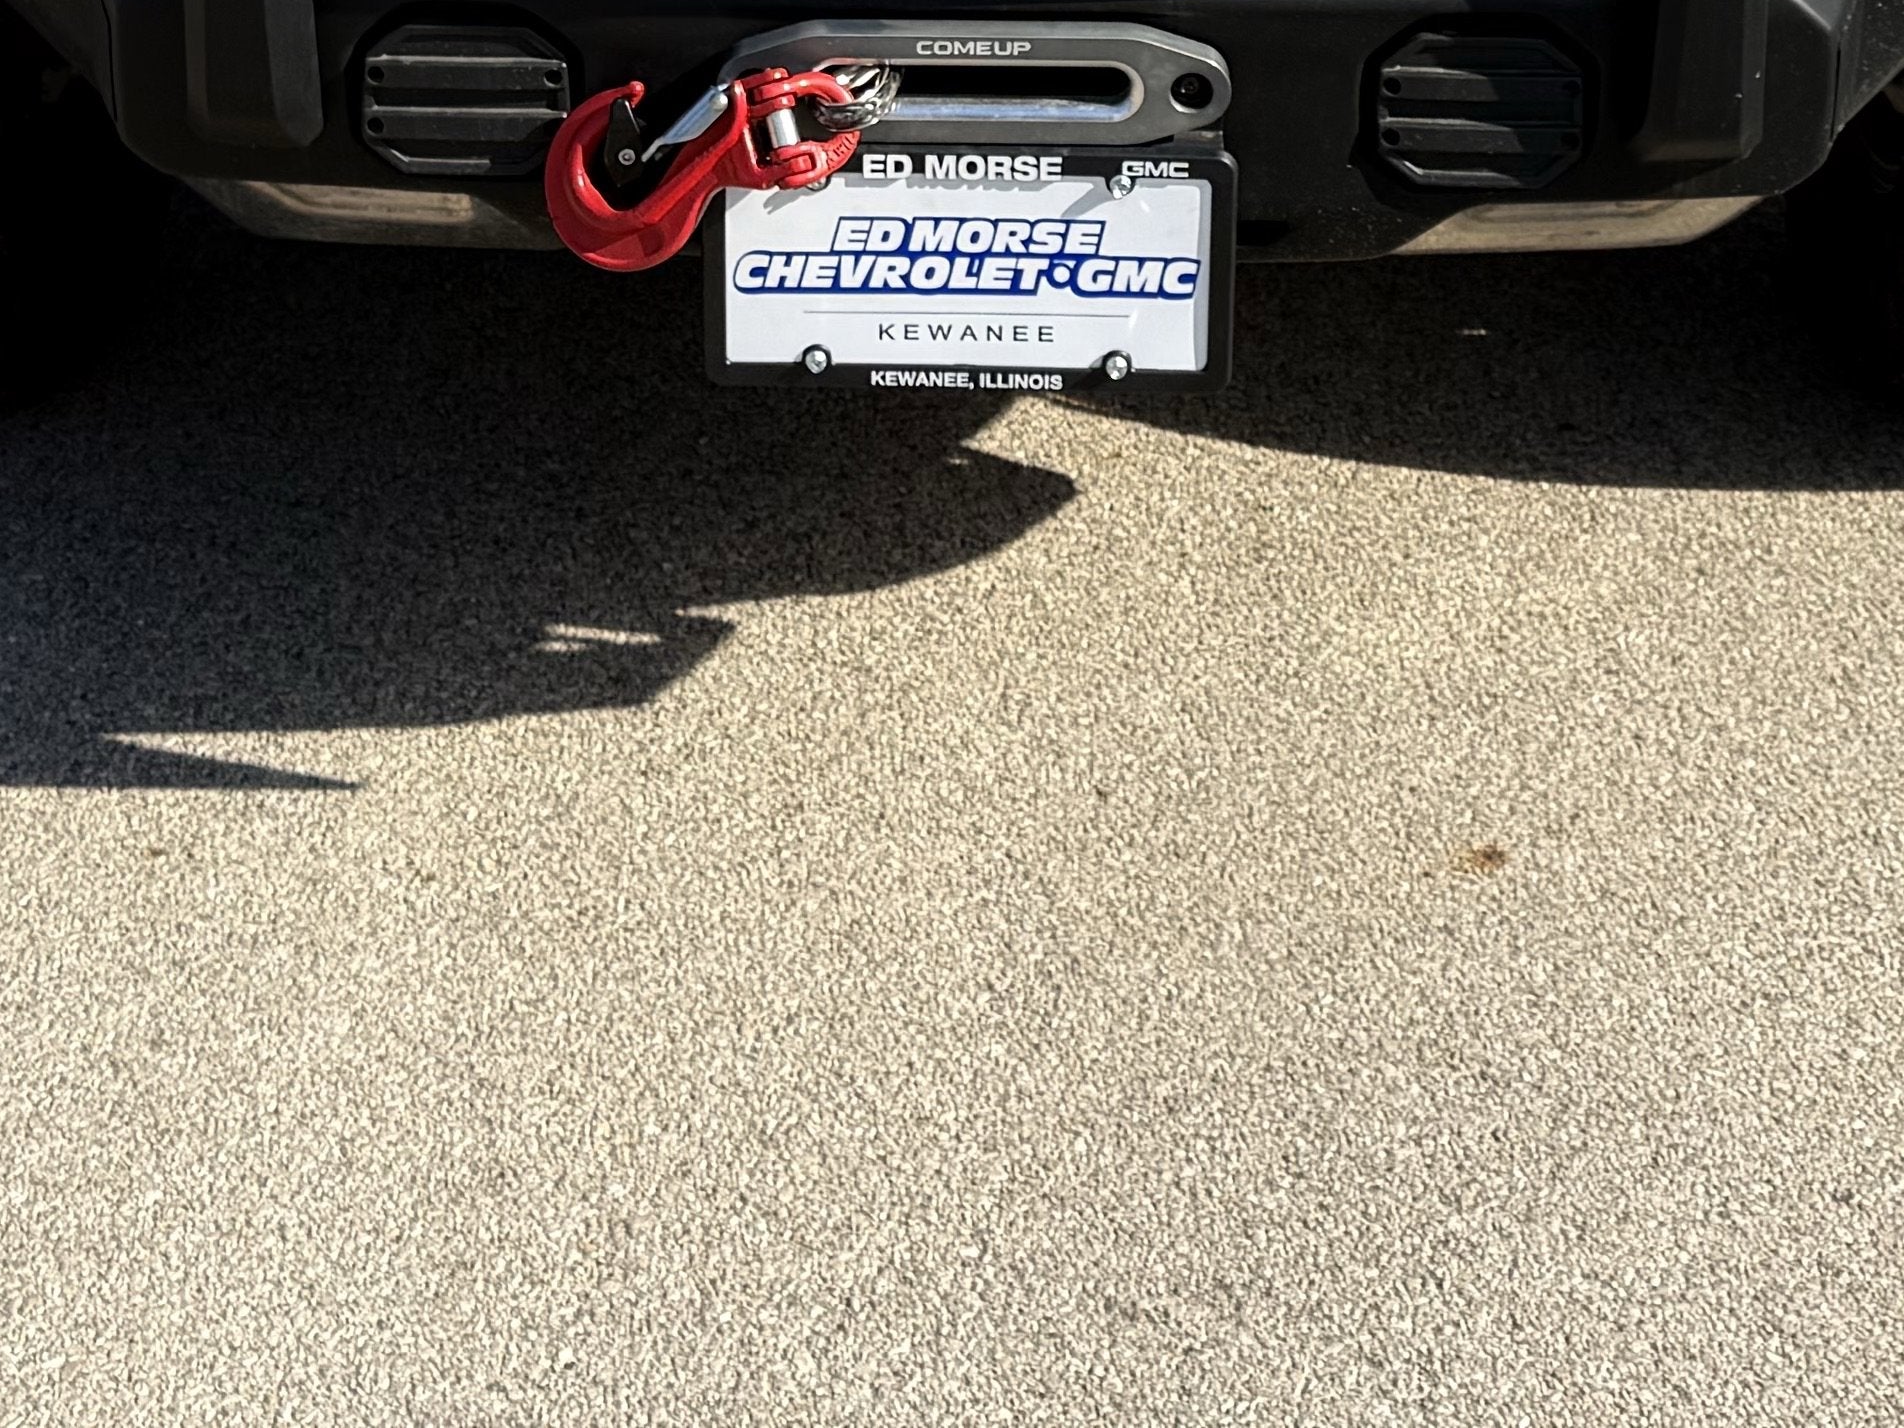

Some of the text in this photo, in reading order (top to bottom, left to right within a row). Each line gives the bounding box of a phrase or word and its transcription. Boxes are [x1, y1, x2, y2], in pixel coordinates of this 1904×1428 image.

[916, 40, 1032, 56] COMEUP
[862, 153, 1064, 182] ED MORSE
[1121, 160, 1190, 178] GMC
[833, 218, 1105, 255] ED MORSE
[878, 323, 1055, 343] KEWANEE
[870, 370, 1064, 391] KEWANEE, ILLINOIS
